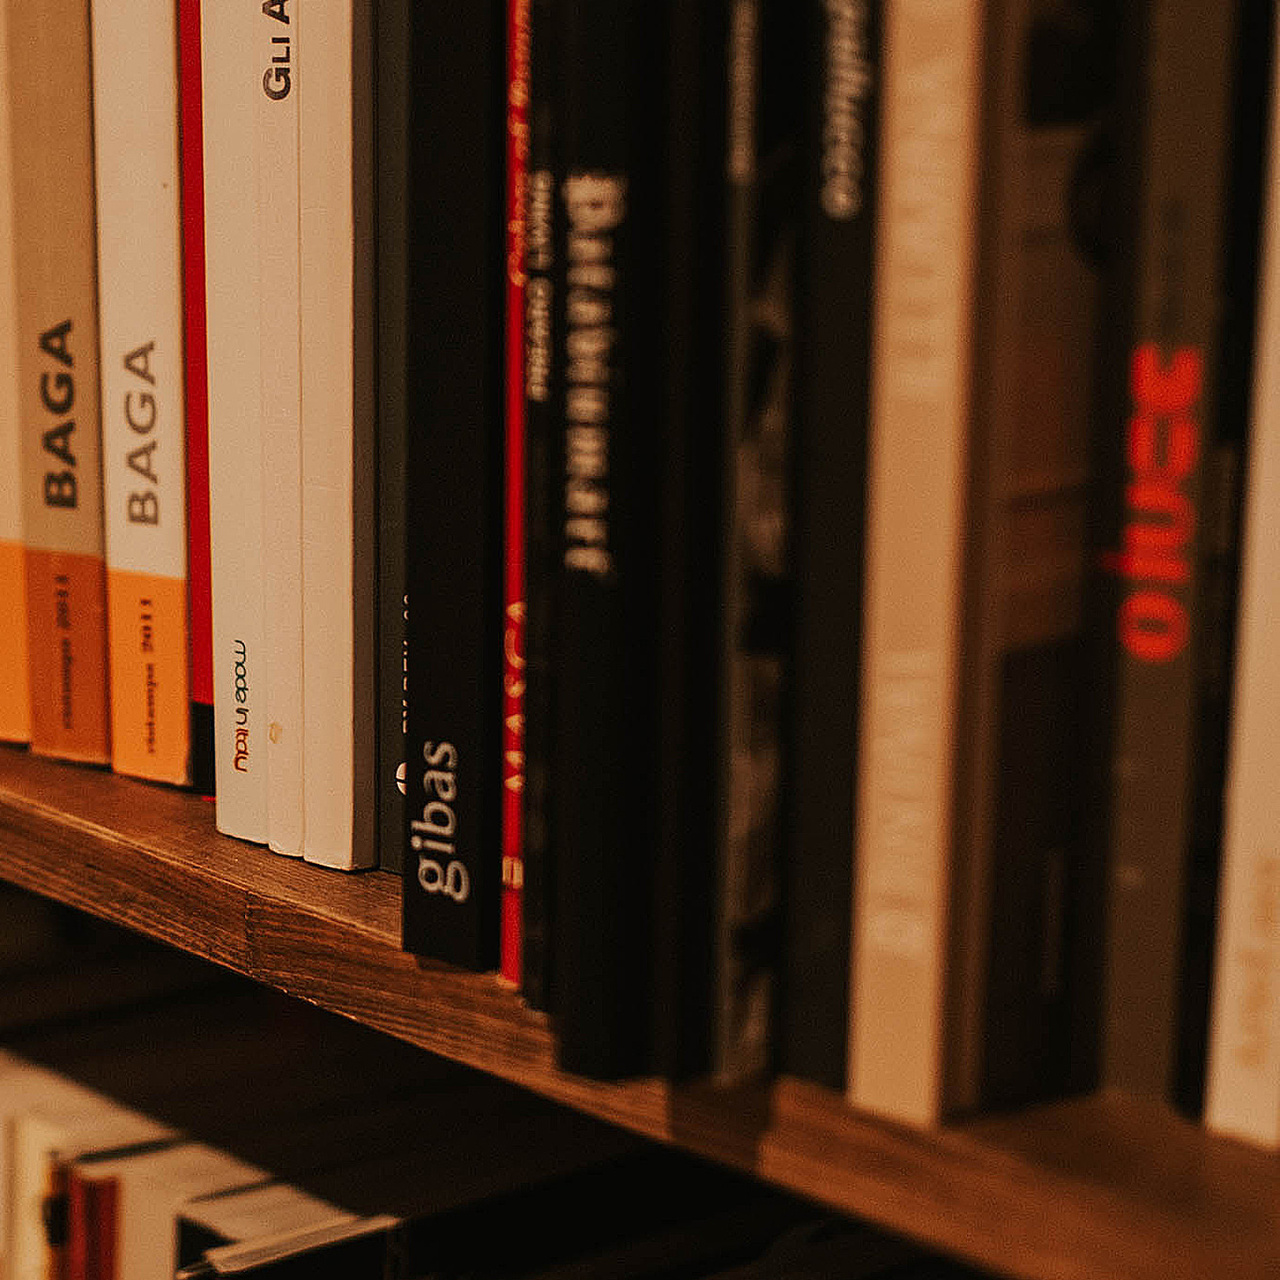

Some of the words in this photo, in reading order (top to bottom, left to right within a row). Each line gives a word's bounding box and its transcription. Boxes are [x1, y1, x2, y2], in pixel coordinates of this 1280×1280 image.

[38, 320, 79, 510] BAGA
[123, 341, 160, 527] BAGA
[139, 598, 155, 654] 2011
[233, 639, 249, 704] made
[411, 739, 471, 904] gibas
